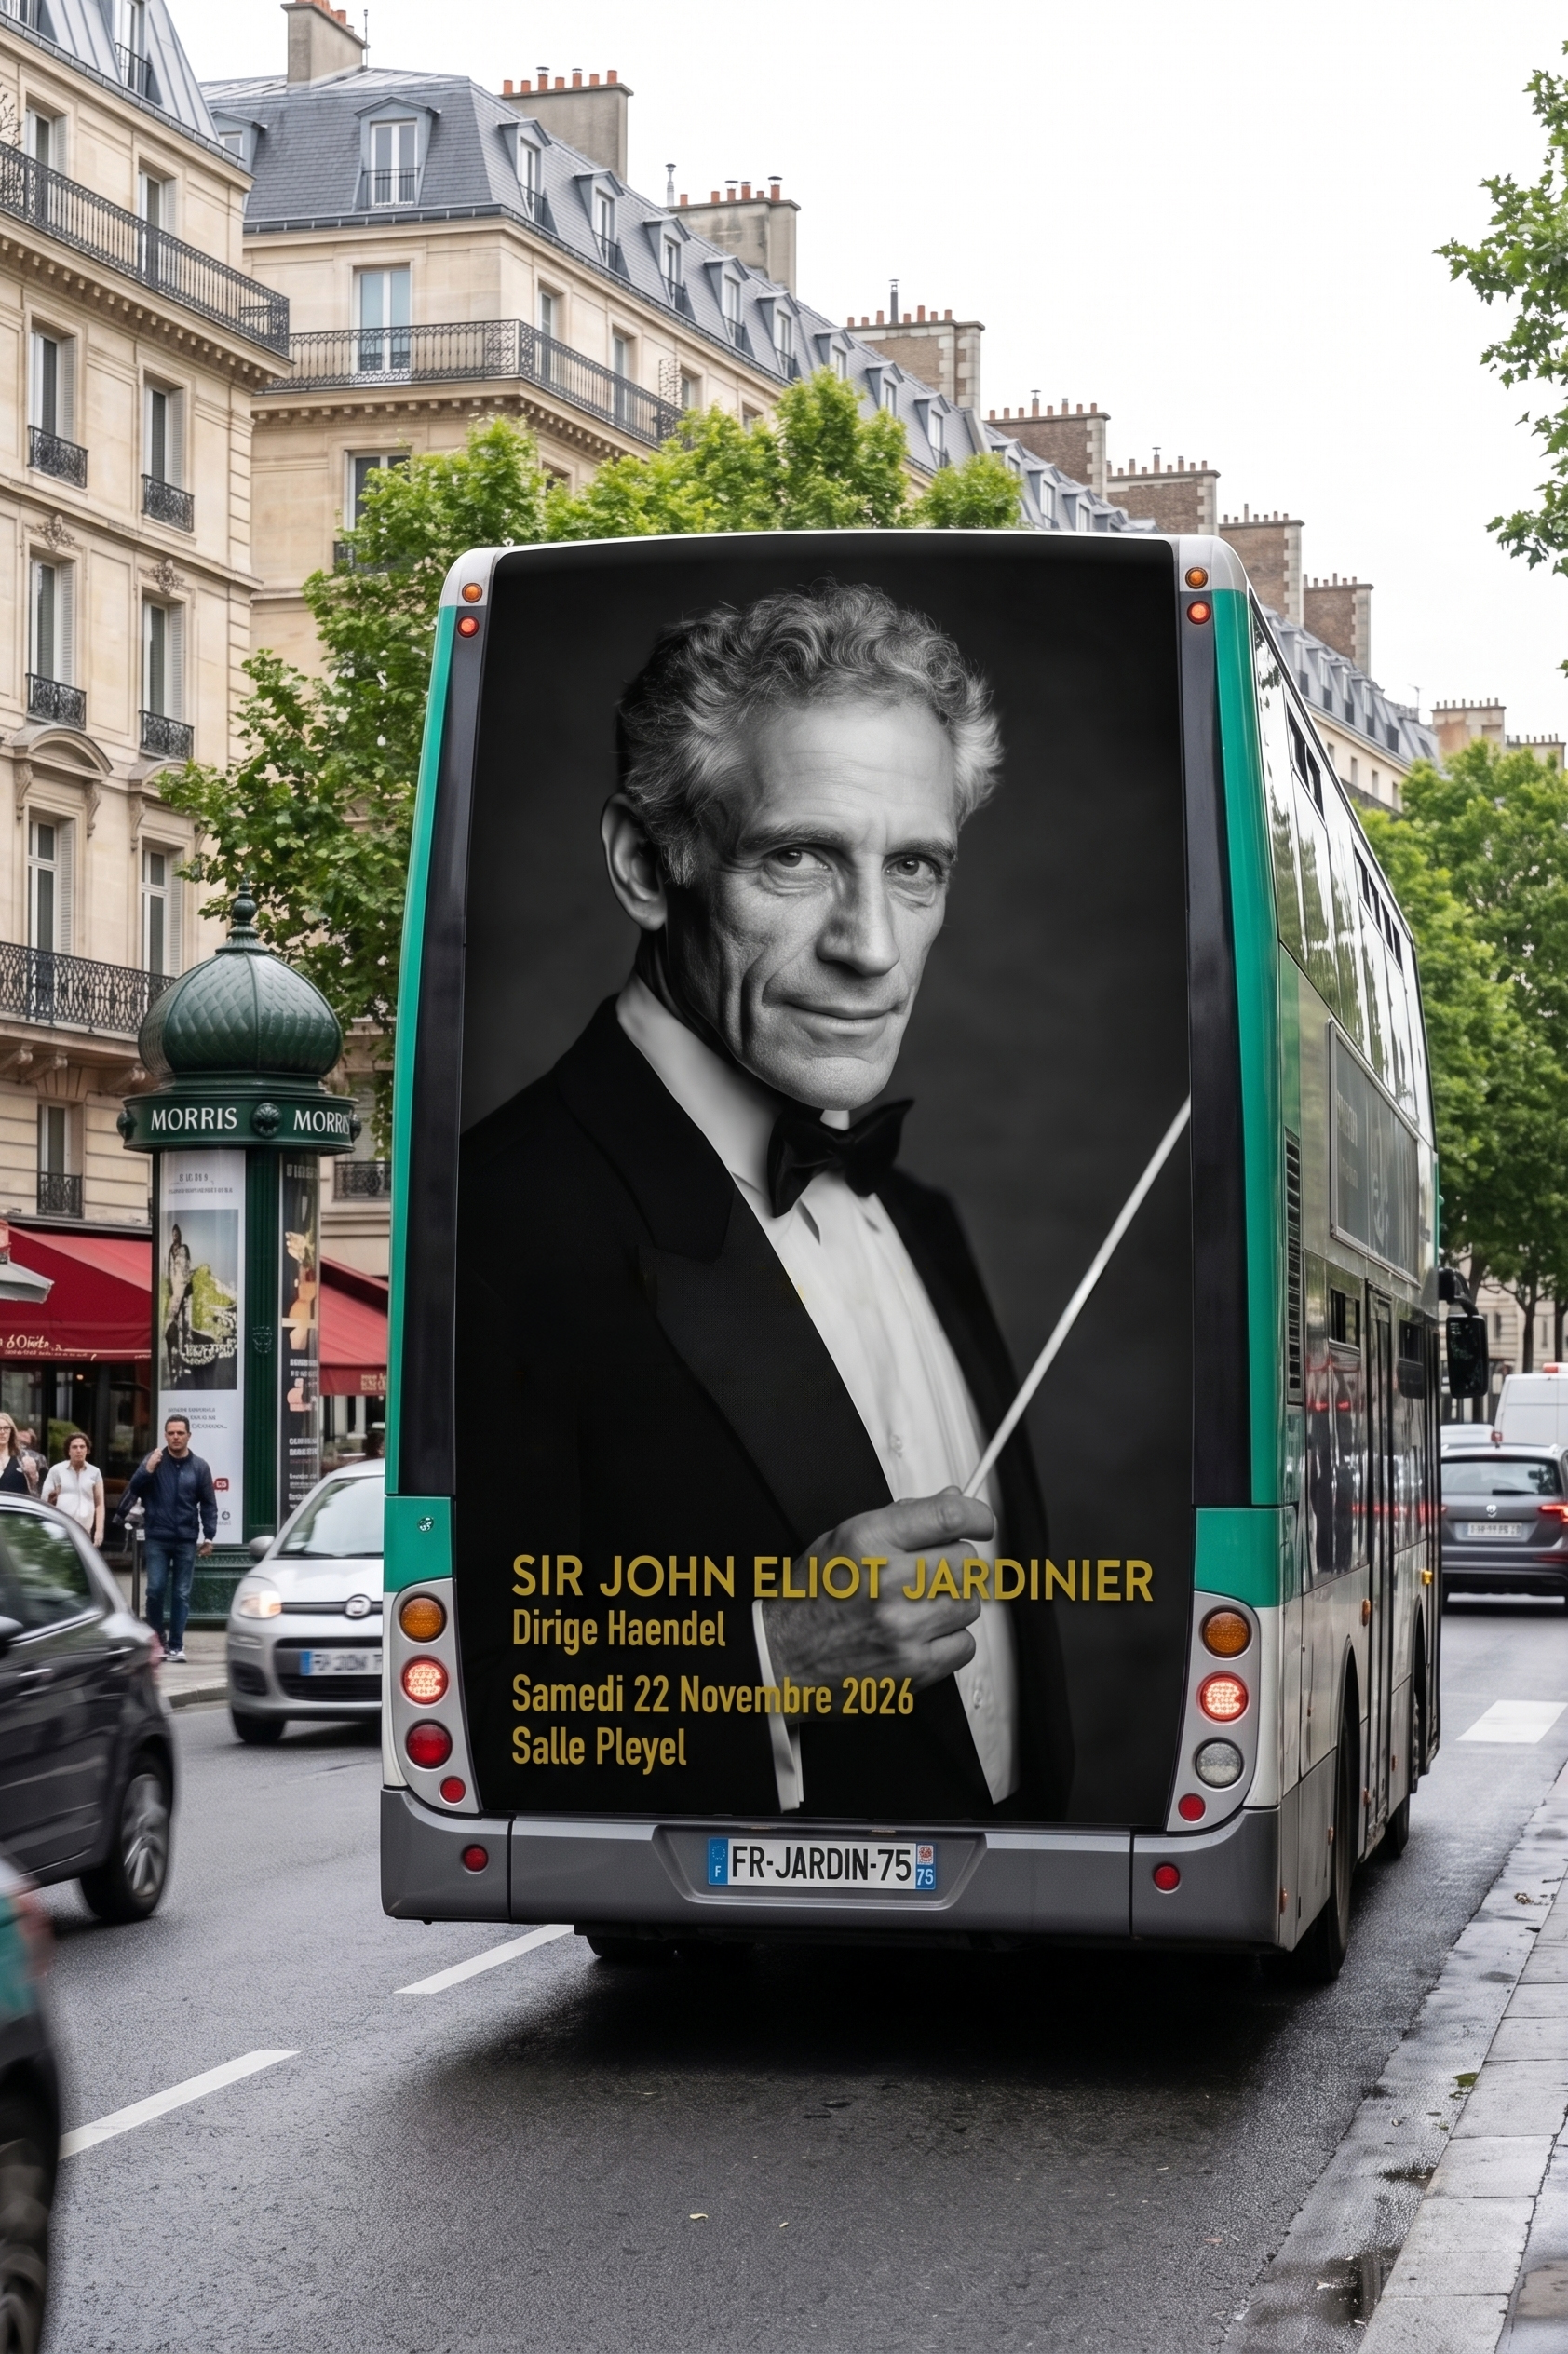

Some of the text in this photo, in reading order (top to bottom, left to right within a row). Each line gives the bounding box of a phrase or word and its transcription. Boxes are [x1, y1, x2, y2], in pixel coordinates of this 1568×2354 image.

[151, 1107, 237, 1130] MORRIS
[512, 1554, 1154, 1602] SIR JOHN ELIOT JARDINIER
[513, 1608, 725, 1656] Dirige Haendel
[512, 1673, 914, 1715] Samedi 22 Novembre 2026
[512, 1725, 687, 1775] Salle Pleyel
[714, 1865, 722, 1878] F
[732, 1845, 912, 1882] FR-JARDIN-75
